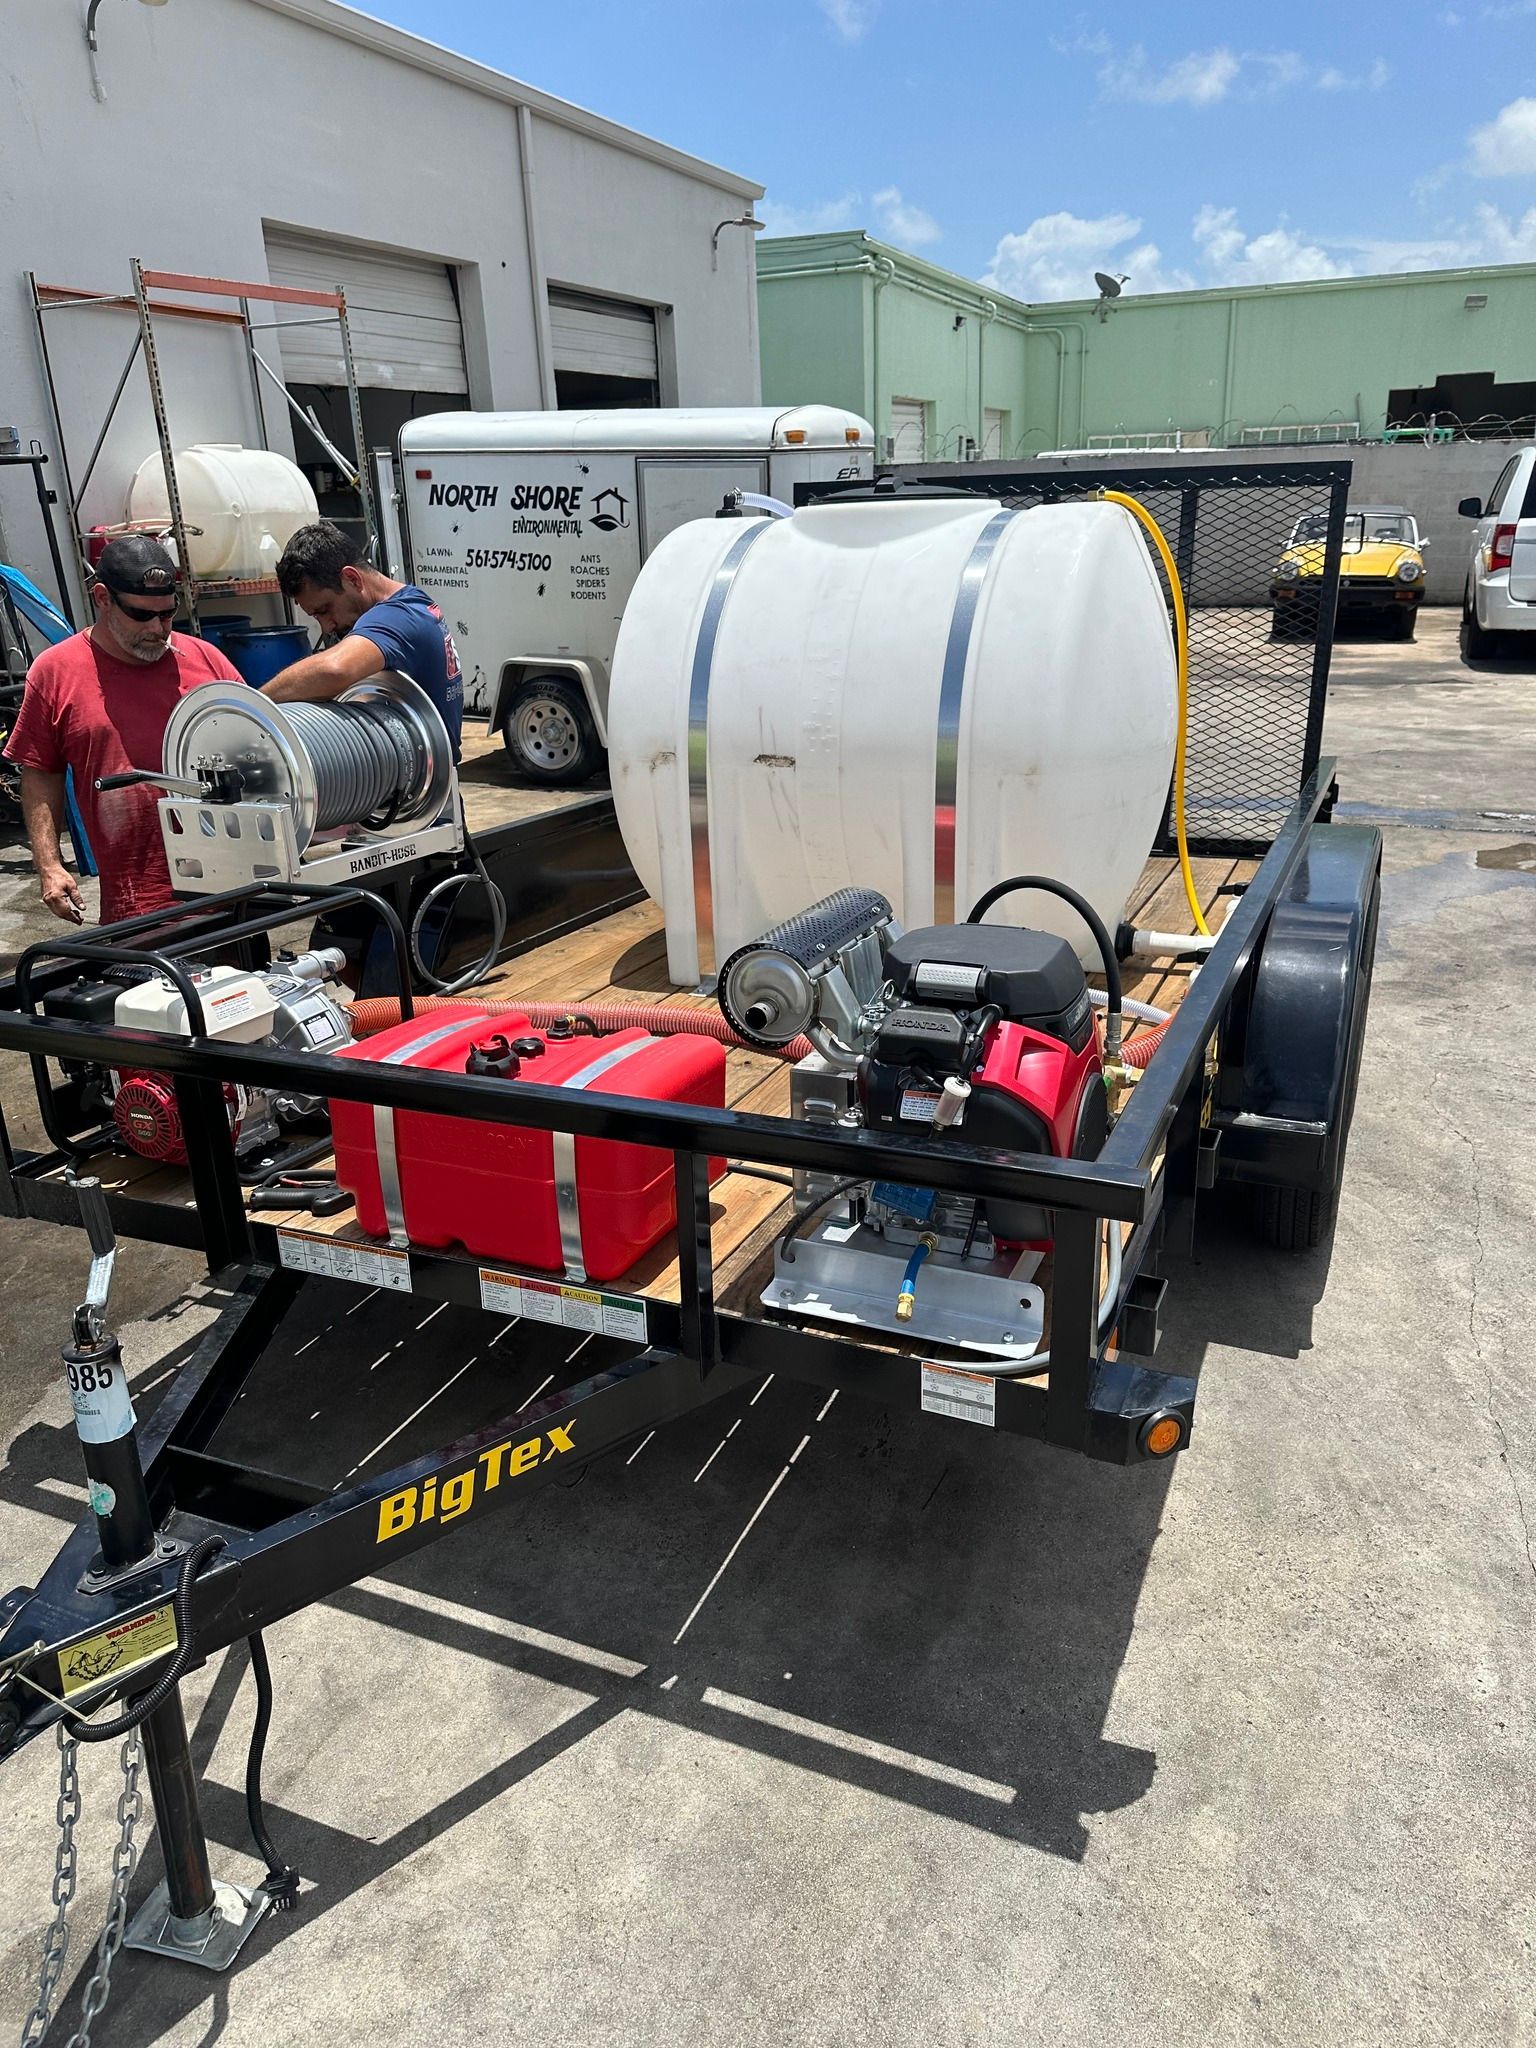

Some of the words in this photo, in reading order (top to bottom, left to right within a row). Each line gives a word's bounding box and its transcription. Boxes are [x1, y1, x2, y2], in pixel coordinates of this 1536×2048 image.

[429, 484, 498, 512] NORTH
[511, 485, 584, 517] SHORE
[513, 516, 583, 538] ENVIRONMENTAL
[580, 555, 601, 564] ANTS
[417, 564, 469, 576] ORNAMENTAL
[570, 565, 610, 576] ROACHES
[420, 577, 469, 588] TREATMENTS
[576, 579, 606, 588] SPIDERS
[570, 591, 606, 600] RODENTS
[891, 1018, 950, 1032] HONDA
[130, 1112, 154, 1121] HONDA
[133, 1120, 153, 1131] GX
[484, 1272, 517, 1286] WARNING
[569, 1290, 599, 1302] CAUTION
[67, 1362, 113, 1392] 985
[105, 1613, 157, 1640] WARNING
